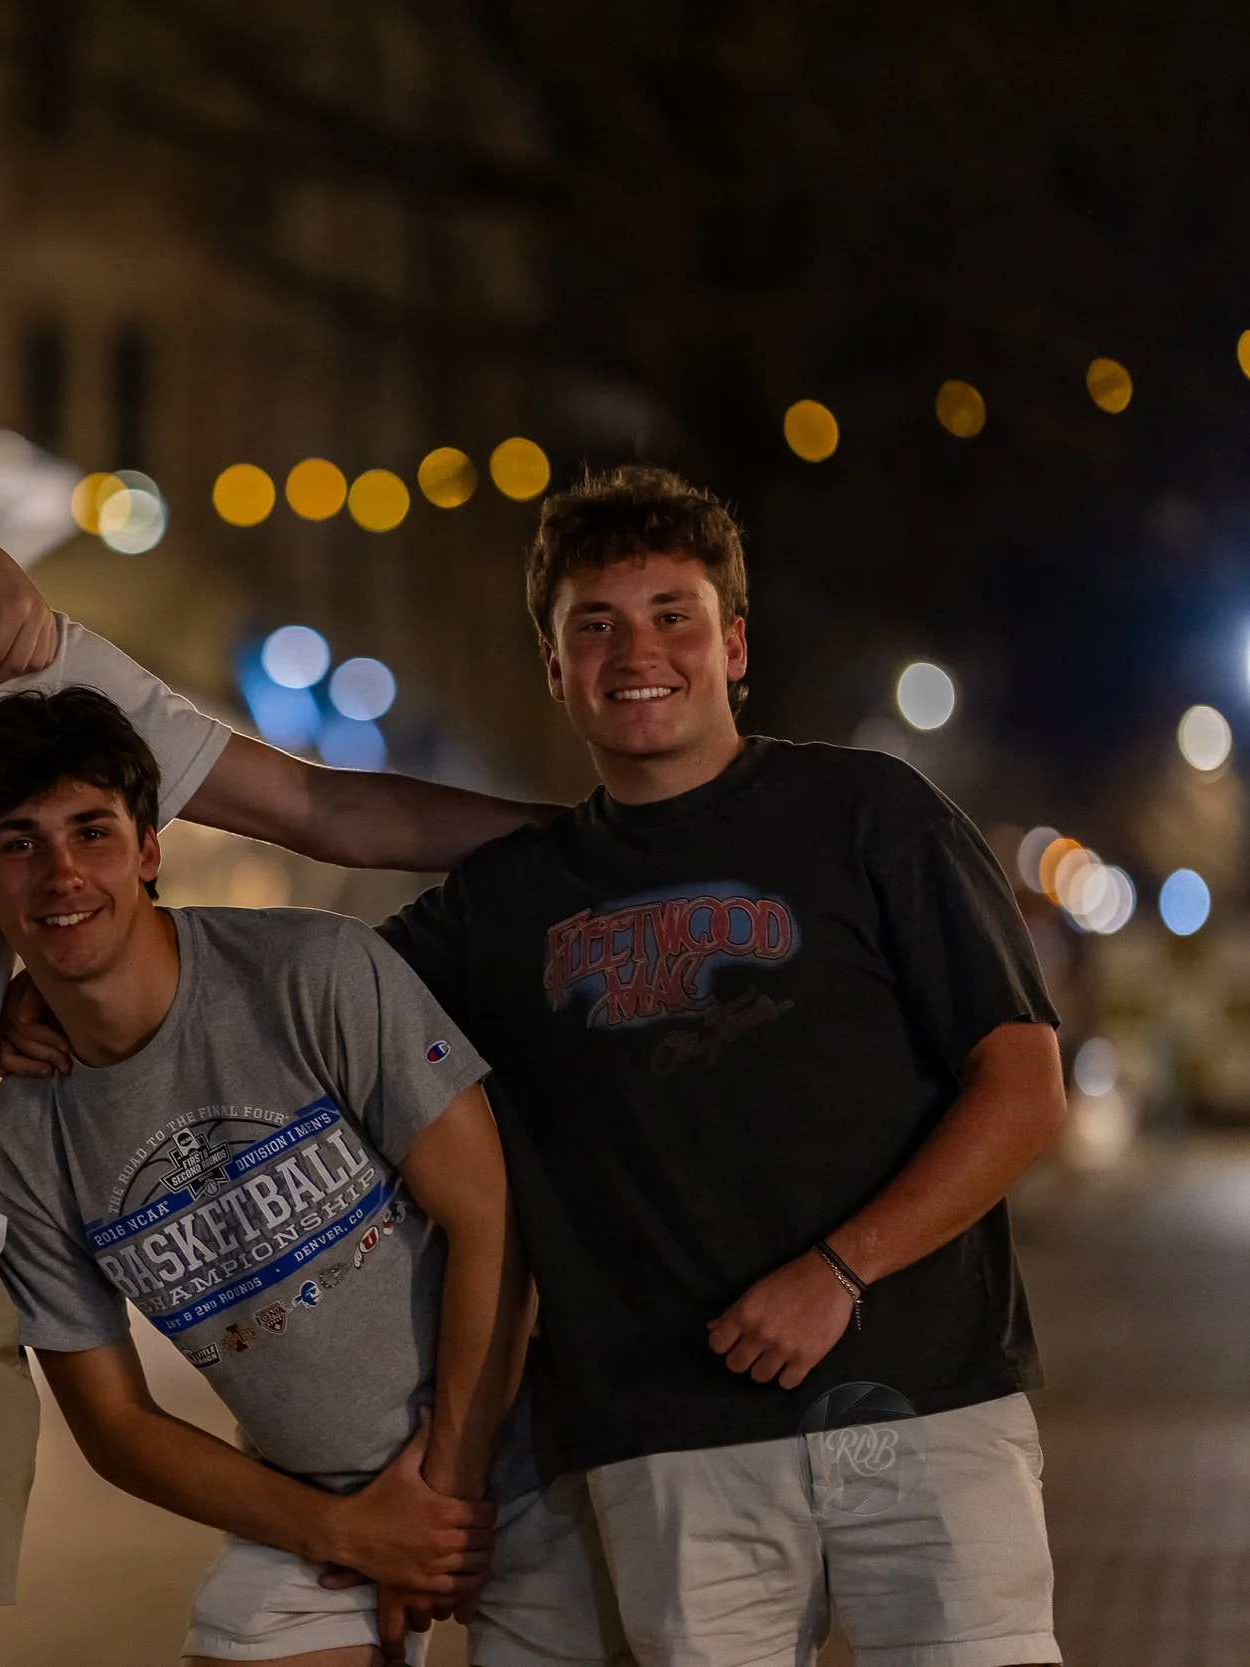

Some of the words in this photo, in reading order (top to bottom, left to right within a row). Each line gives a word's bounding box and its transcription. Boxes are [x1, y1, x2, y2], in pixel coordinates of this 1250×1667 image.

[544, 896, 791, 1013] FLEETWOOD
[587, 950, 717, 1028] MAC
[94, 1225, 126, 1247] 2016
[235, 1135, 288, 1171] DIVISION
[294, 1112, 332, 1139] MEN'S
[97, 1128, 370, 1298] BASKETBALL
[109, 1186, 124, 1214] THE
[118, 1148, 148, 1186] ROAD
[146, 1130, 166, 1148] TO
[166, 1111, 196, 1132] THE
[198, 1105, 238, 1119] FINAL
[171, 1164, 202, 1186] SECOND
[182, 1151, 204, 1169] FIRST
[138, 1167, 376, 1312] CHAMPIONSHIP
[164, 1319, 181, 1329] 1ST
[195, 1299, 218, 1317] 2ND
[218, 1277, 263, 1304] ROUNDS
[294, 1225, 349, 1263] DENVER,
[349, 1208, 364, 1225] CO
